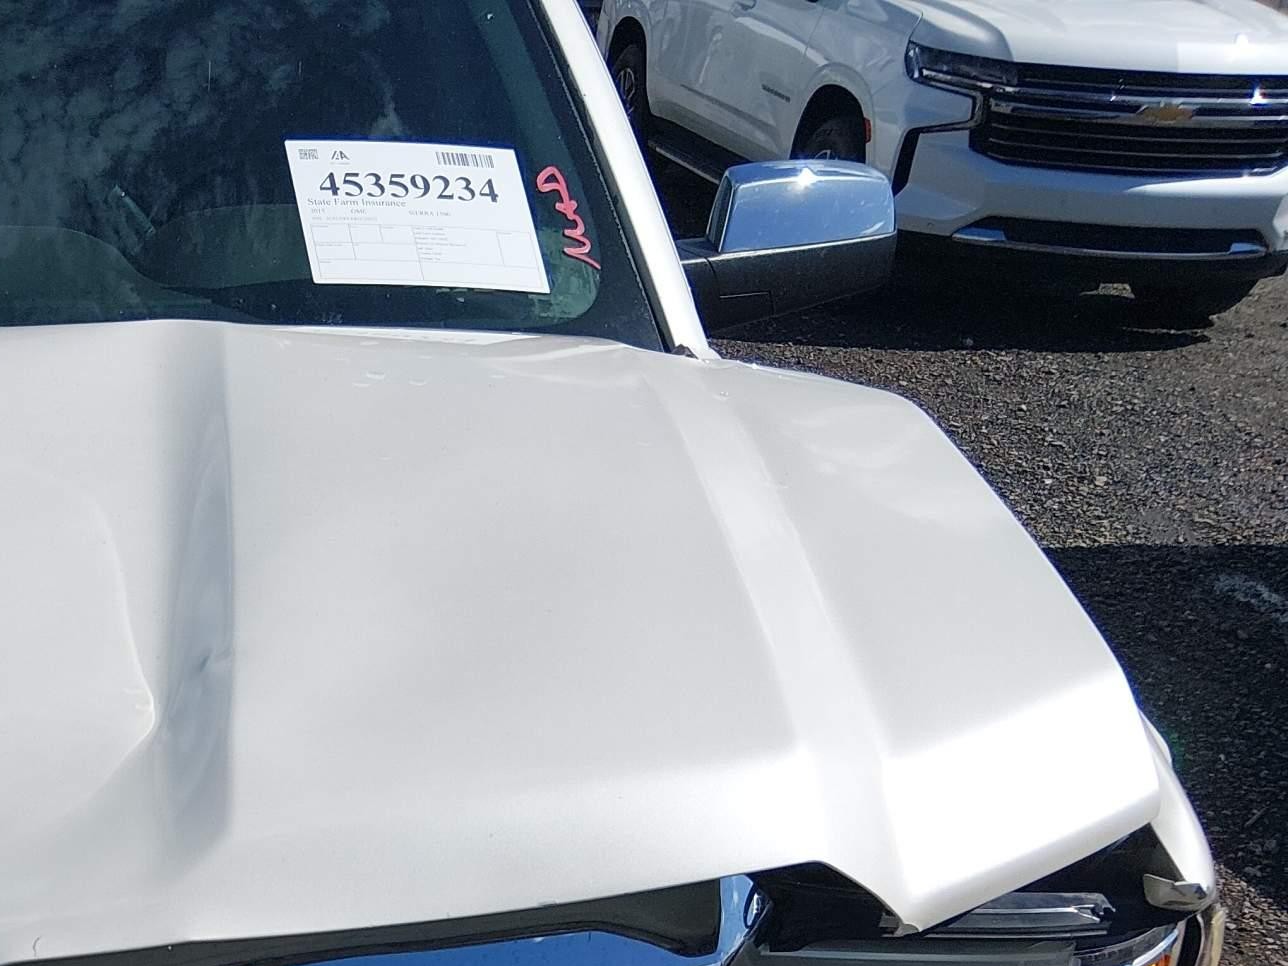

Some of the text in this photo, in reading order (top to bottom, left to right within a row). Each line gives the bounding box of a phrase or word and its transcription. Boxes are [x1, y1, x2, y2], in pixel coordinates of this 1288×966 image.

[319, 171, 499, 203] 45359234
[307, 198, 407, 208] State Farm Insurance
